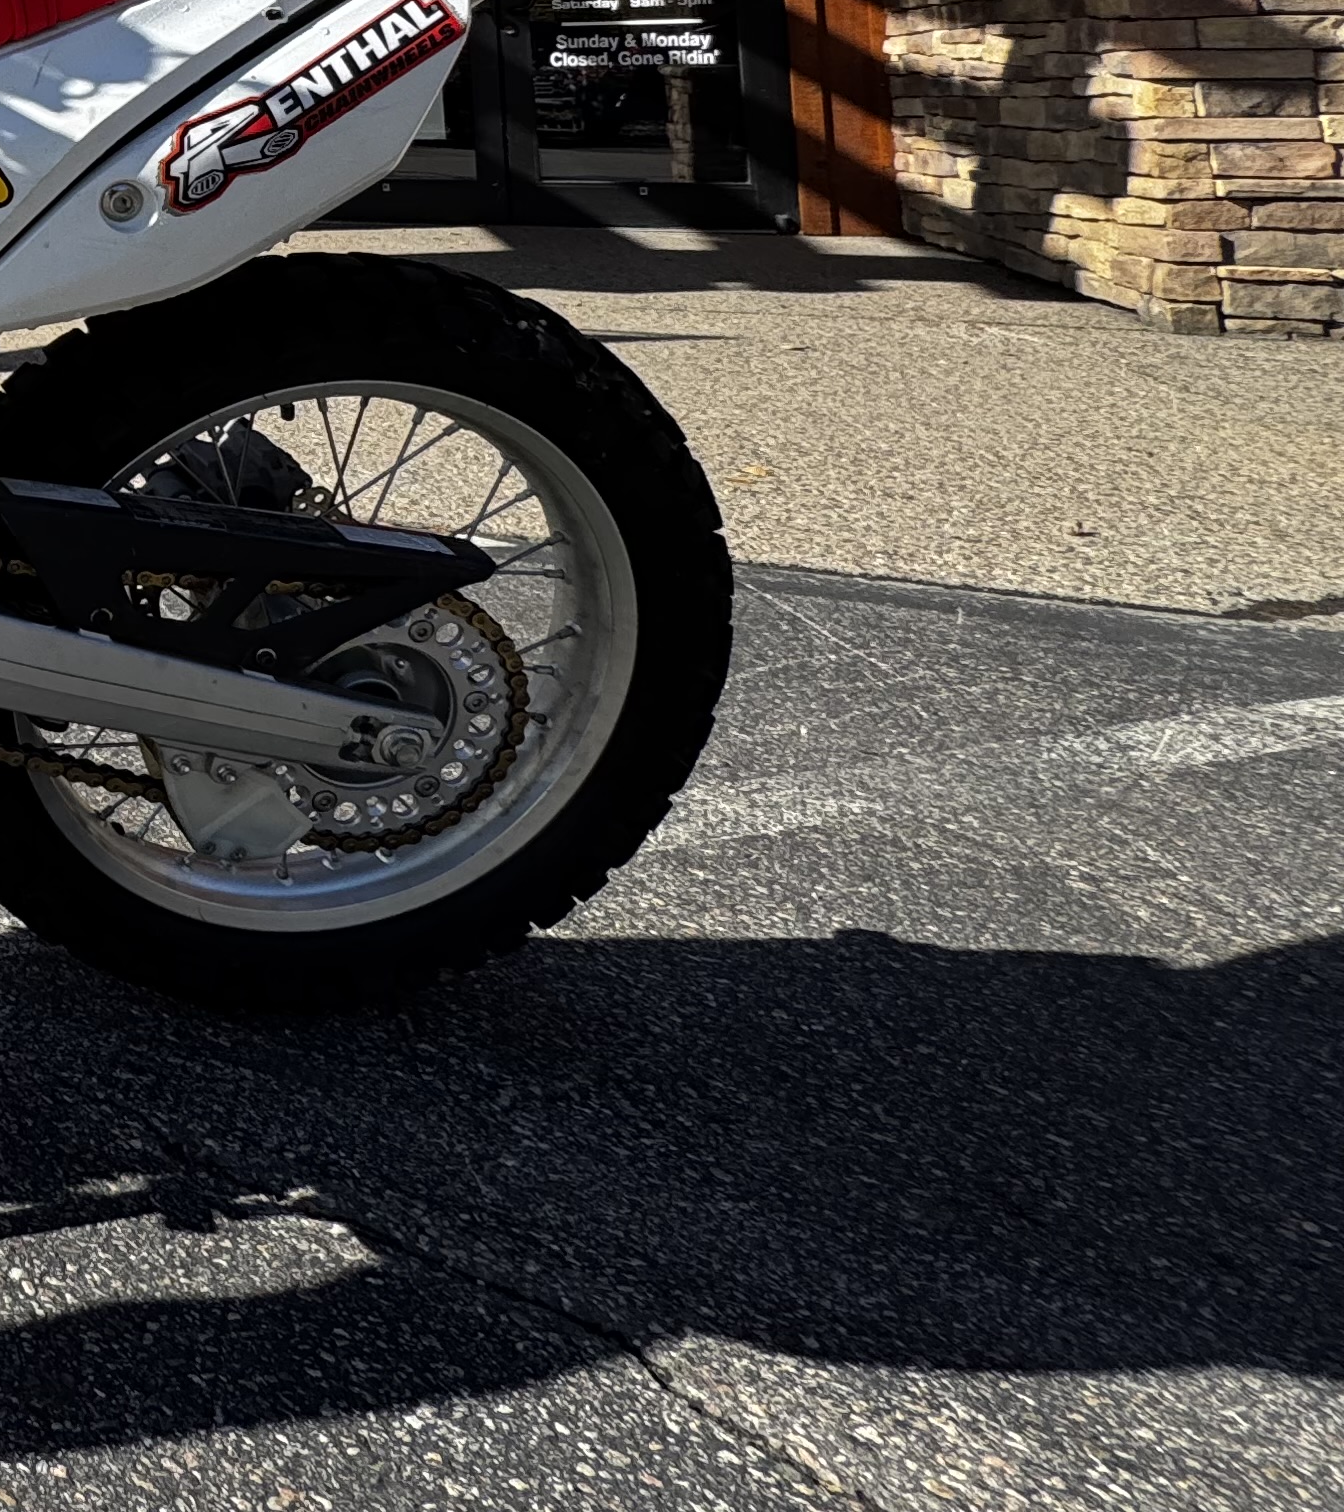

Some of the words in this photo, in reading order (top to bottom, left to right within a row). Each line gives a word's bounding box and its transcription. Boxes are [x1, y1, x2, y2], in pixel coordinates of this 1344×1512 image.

[555, 34, 619, 51] Sunday
[624, 33, 637, 48] &
[642, 31, 712, 49] Monday
[549, 51, 613, 68] Closed,
[618, 51, 664, 65] Gone
[668, 49, 722, 65] Ridin'
[302, 22, 456, 133] CHAINWHEELS
